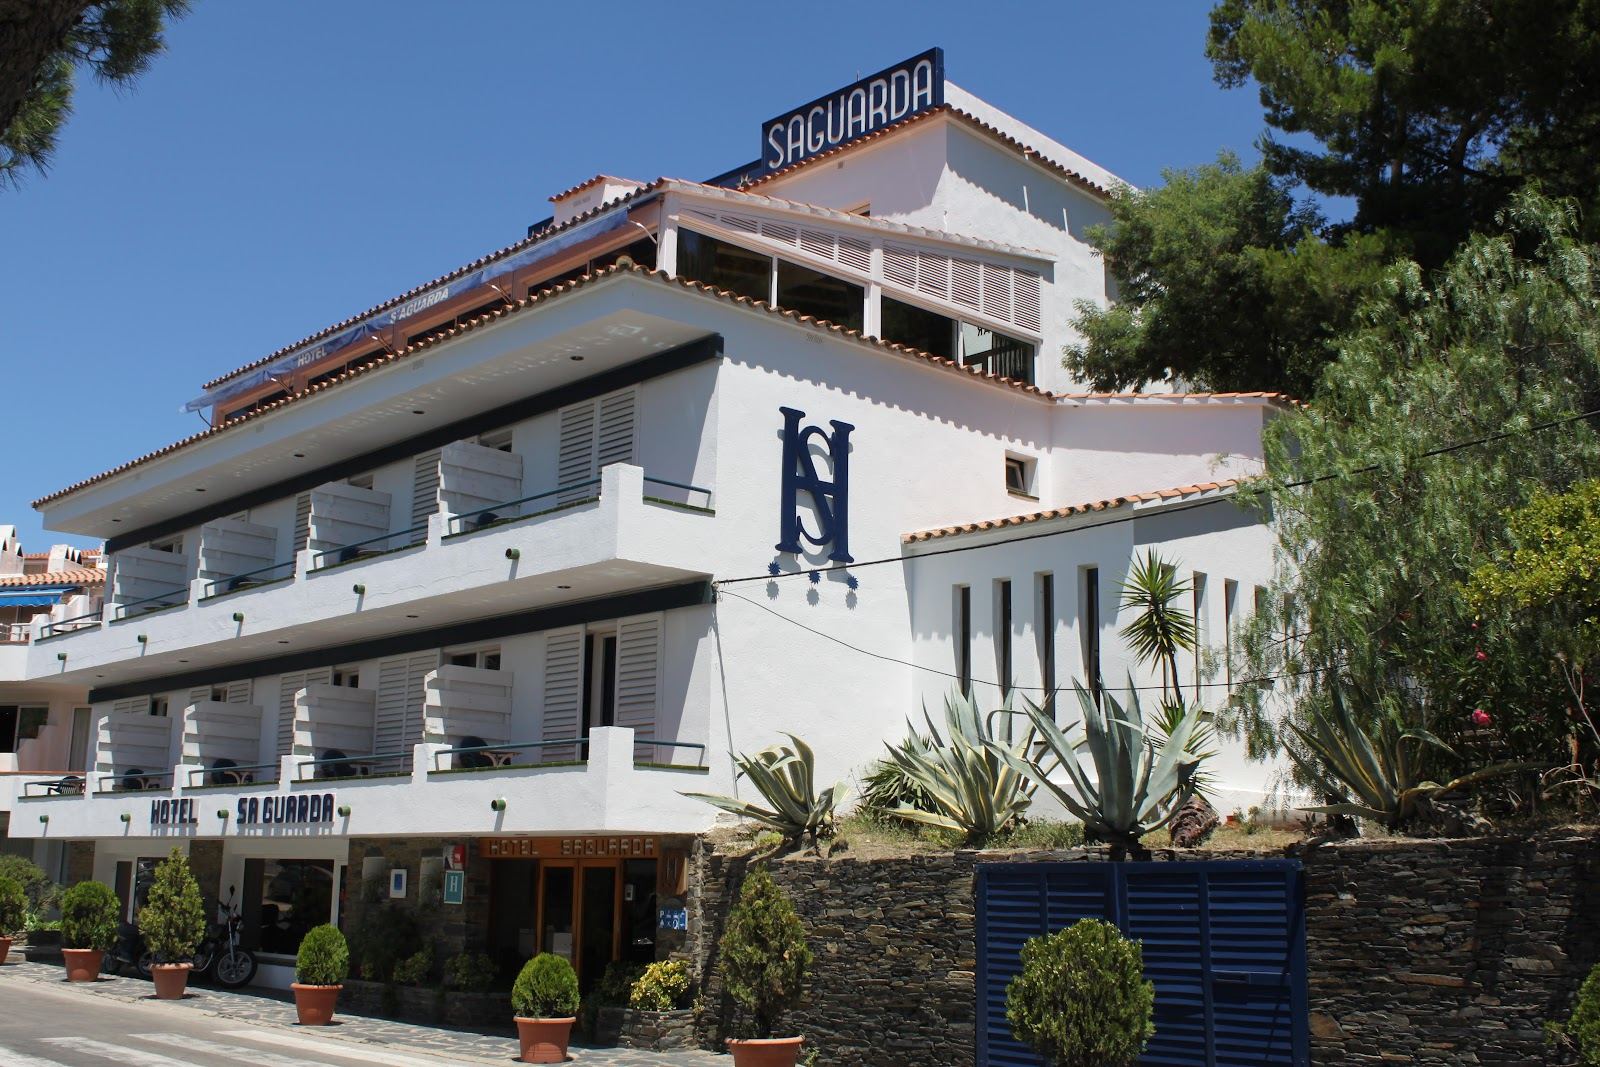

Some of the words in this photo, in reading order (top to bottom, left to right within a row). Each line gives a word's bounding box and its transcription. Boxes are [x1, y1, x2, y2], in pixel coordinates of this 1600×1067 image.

[768, 58, 932, 169] SAGUARDA
[297, 345, 328, 368] HOTEL
[150, 799, 198, 824] HOTEL
[263, 794, 335, 823] GUARDA
[489, 839, 539, 856] HOTEL
[560, 838, 654, 856] SAGUARDA
[449, 875, 459, 893] H
